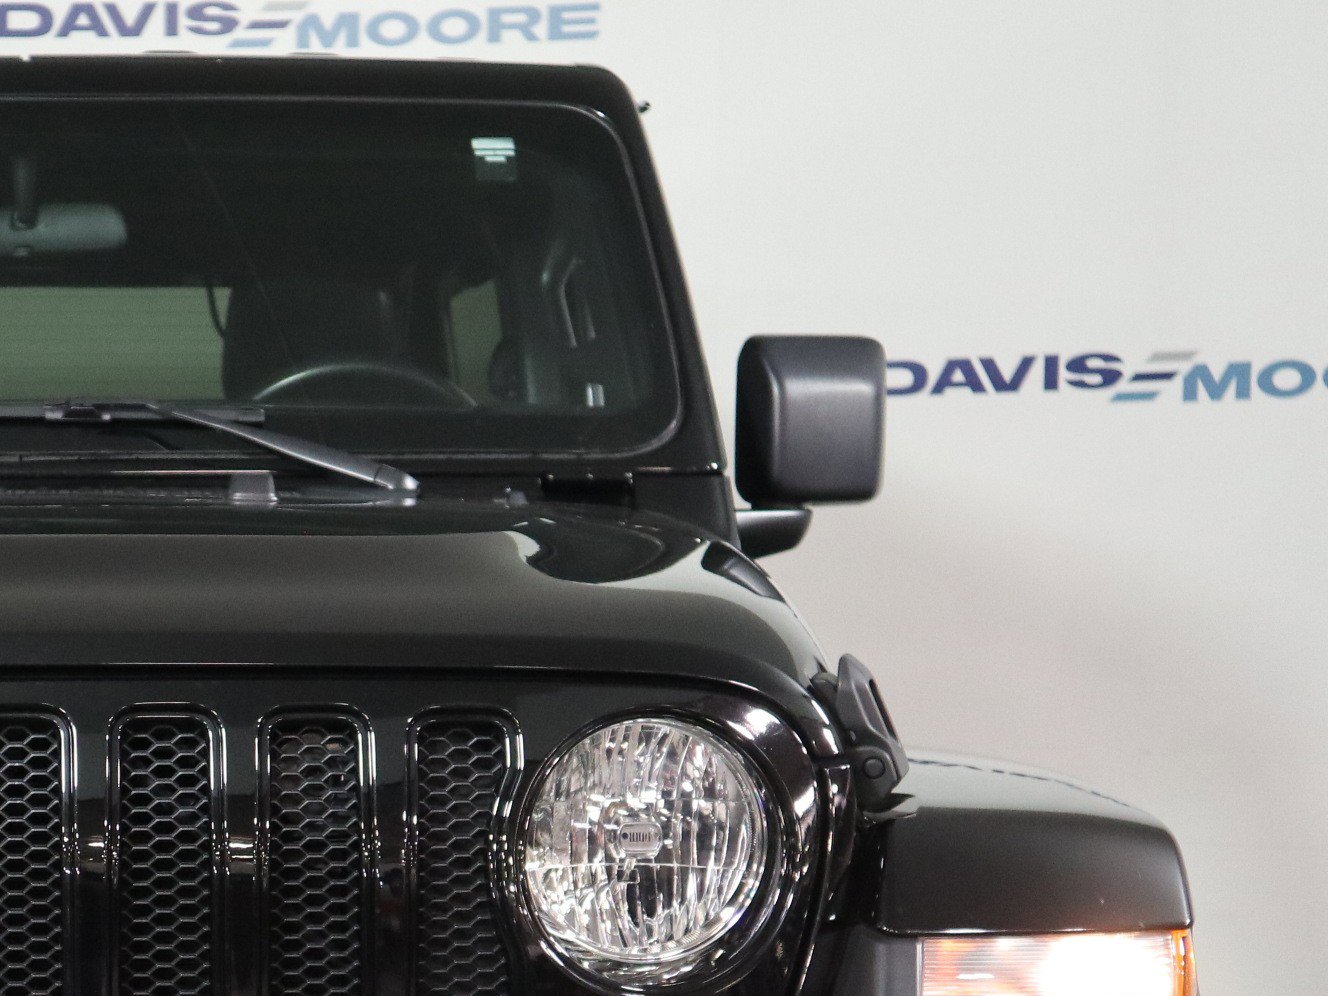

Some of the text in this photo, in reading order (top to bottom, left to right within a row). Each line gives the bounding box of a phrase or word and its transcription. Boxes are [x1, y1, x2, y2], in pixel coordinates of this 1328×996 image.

[294, 2, 601, 49] MOORE
[886, 353, 1328, 403] DAVIS MO
